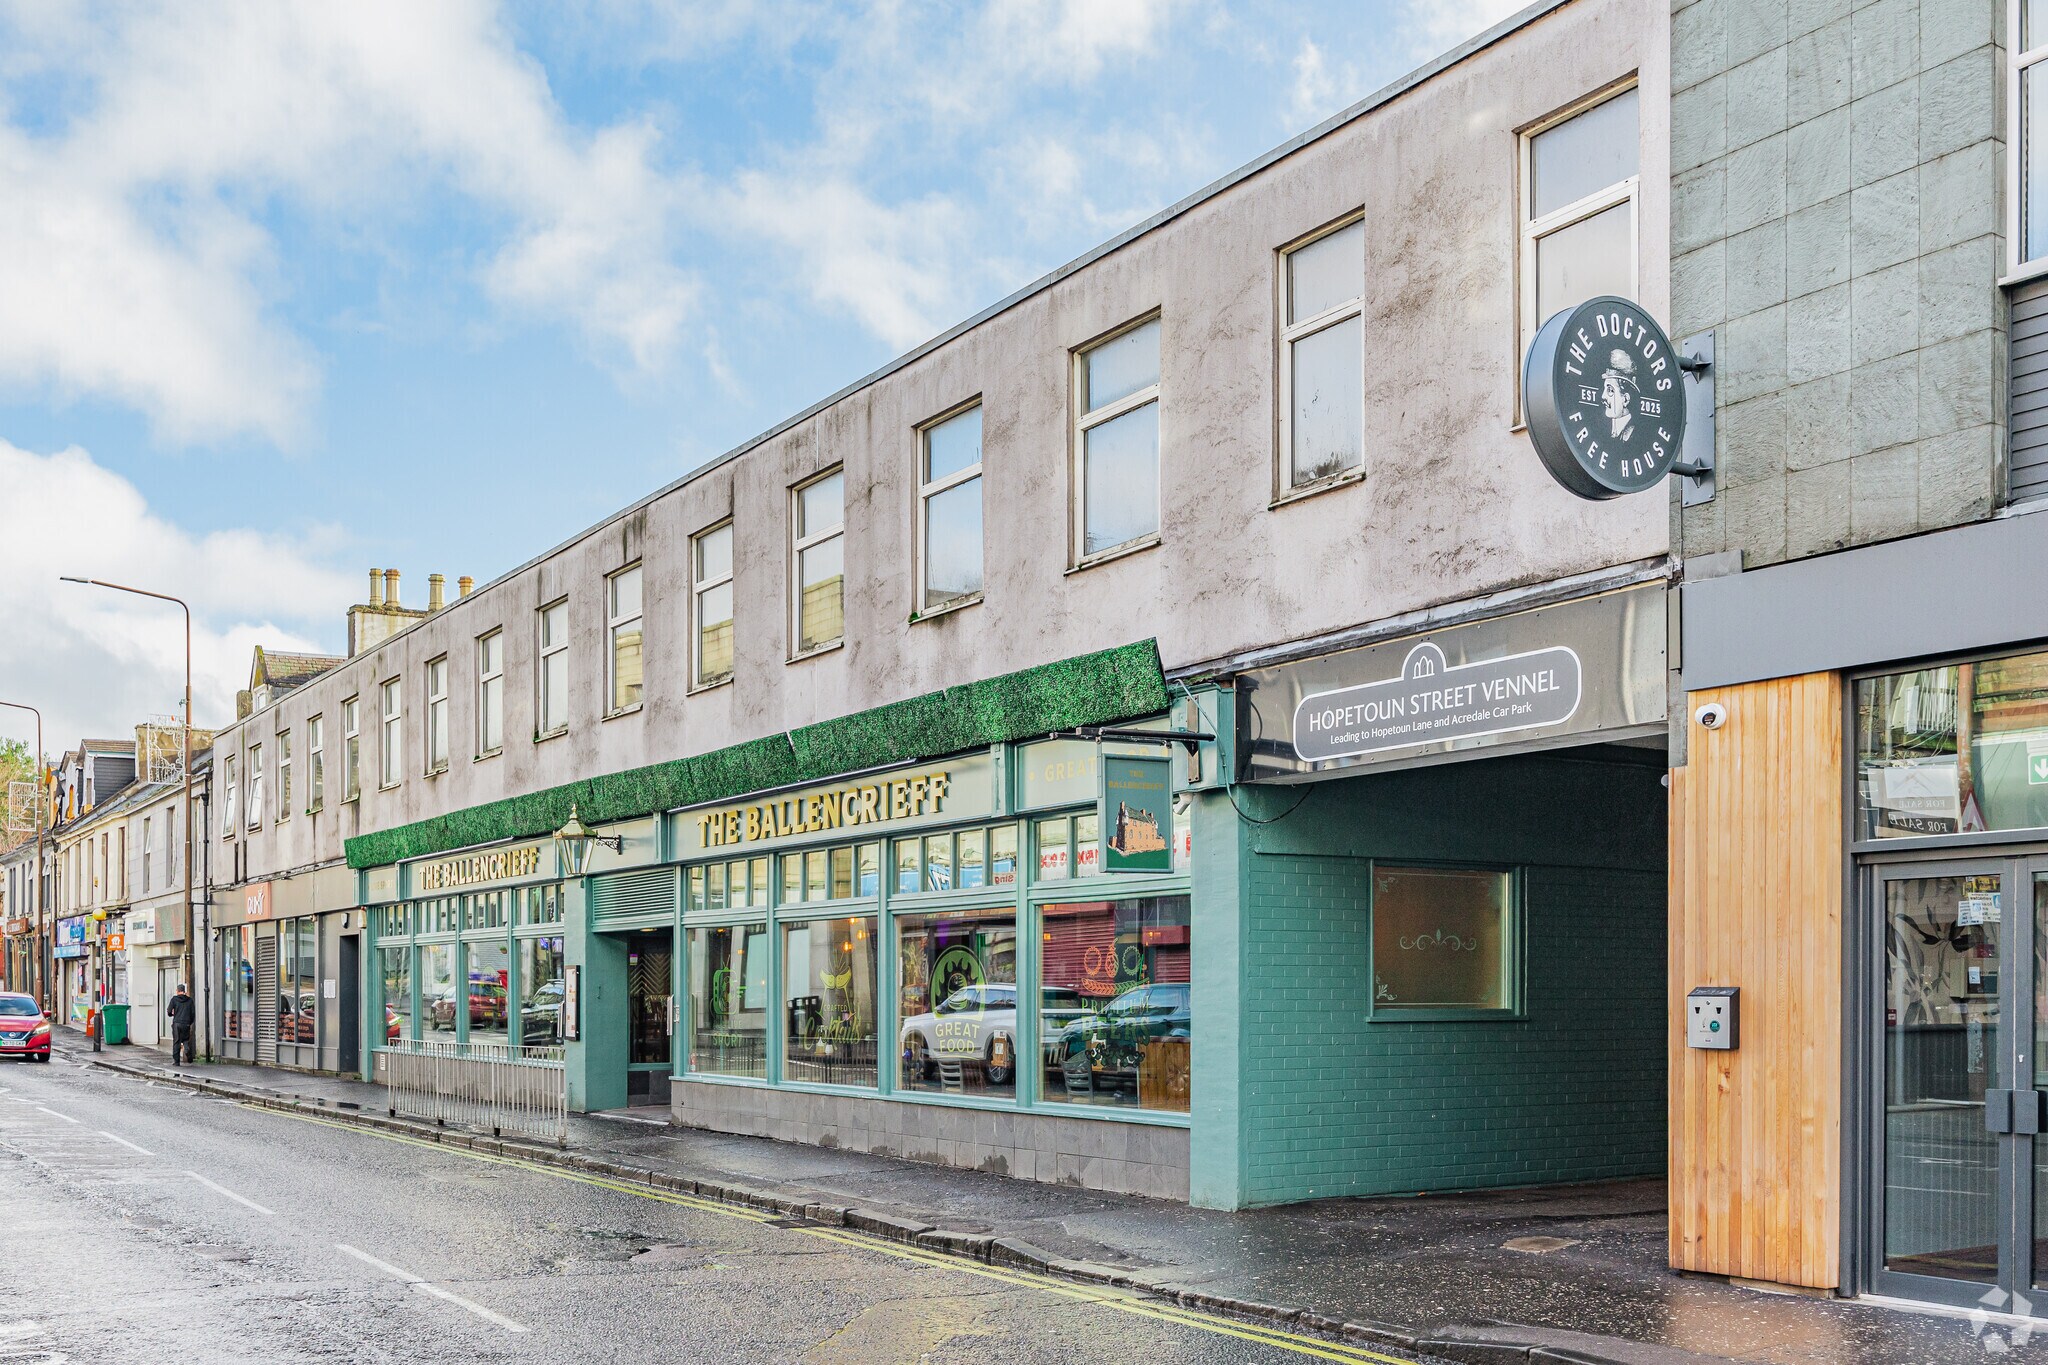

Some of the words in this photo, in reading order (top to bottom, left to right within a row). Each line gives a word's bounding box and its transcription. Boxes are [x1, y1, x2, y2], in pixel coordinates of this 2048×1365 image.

[1565, 327, 1594, 377] THE
[1596, 312, 1672, 392] DOCTORS
[1581, 389, 1597, 402] EST
[1640, 400, 1661, 414] 2025
[1569, 411, 1609, 469] FREE
[1621, 427, 1671, 478] HOUSE
[1309, 697, 1405, 732] HOPETOUN
[1410, 683, 1477, 715] STREET
[1481, 669, 1560, 702] VENNEL
[1330, 732, 1360, 745] Leading
[1361, 730, 1370, 740] to
[1371, 724, 1411, 738] Hopetoun
[1412, 719, 1433, 732] Lane
[1434, 714, 1450, 728] and
[1451, 708, 1491, 724] Acredale
[1492, 706, 1510, 718] Car
[1511, 701, 1533, 715] Park
[1045, 757, 1097, 782] GREAT
[696, 809, 742, 848] THE
[745, 771, 951, 841] BALLENCRIEFF
[420, 864, 442, 890] THE
[443, 847, 539, 887] BALLENCRIEFF
[823, 1004, 848, 1012] CRAFTED
[1081, 995, 1149, 1015] PREMIUM
[712, 1032, 743, 1047] SPORT
[935, 1021, 980, 1039] GREAT
[1081, 1015, 1150, 1047] BEERS
[939, 1038, 975, 1054] FOOD
